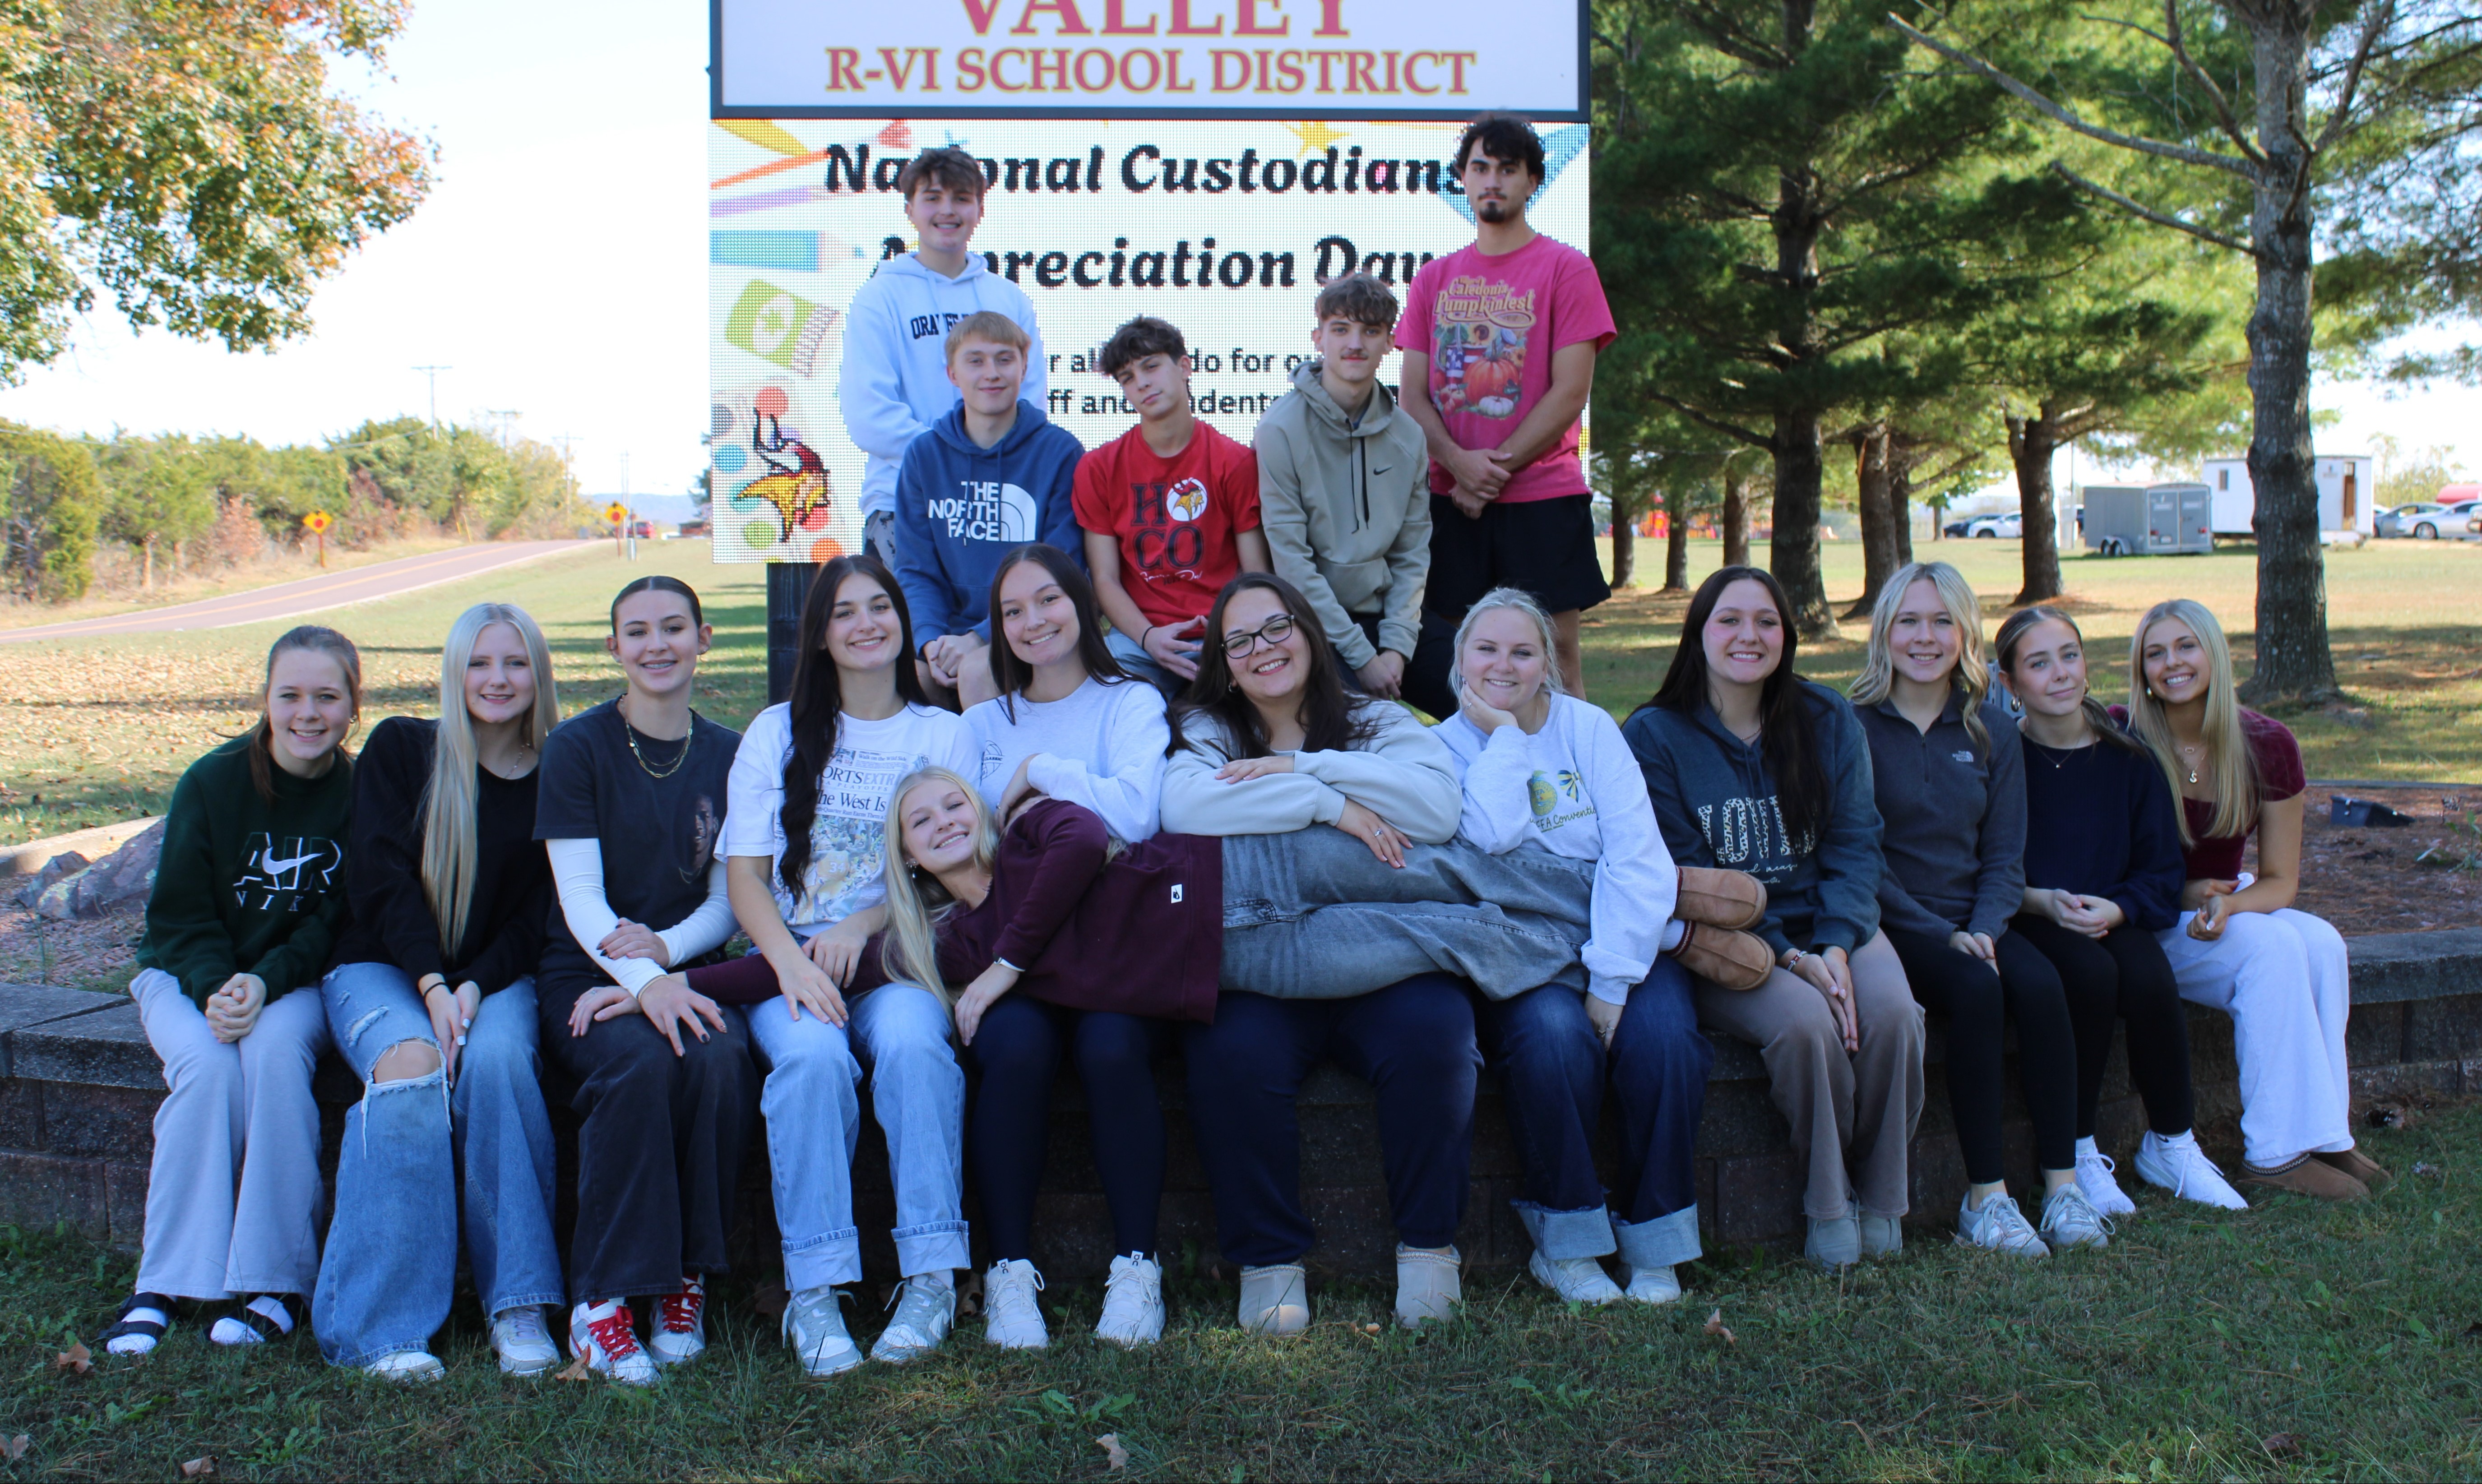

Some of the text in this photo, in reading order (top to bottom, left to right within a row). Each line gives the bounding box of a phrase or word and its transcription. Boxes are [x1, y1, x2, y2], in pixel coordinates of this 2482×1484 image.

[825, 47, 1477, 95] R-VI SCHOOL DISTRICT
[826, 144, 1105, 193] Nanal
[869, 236, 1295, 289] reciation
[1448, 276, 1509, 296] Caledonia
[1434, 287, 1536, 320] Pumpkinfest
[1232, 347, 1276, 372] for
[961, 481, 999, 501] THE
[928, 498, 999, 522] NORTH
[948, 518, 1000, 541] FACE
[838, 783, 888, 792] PLAYOFFS
[818, 790, 887, 812] he West Is
[1698, 795, 1816, 864] LOV
[233, 832, 341, 893] AIR
[829, 862, 845, 873] 34
[236, 891, 304, 911] NIK
